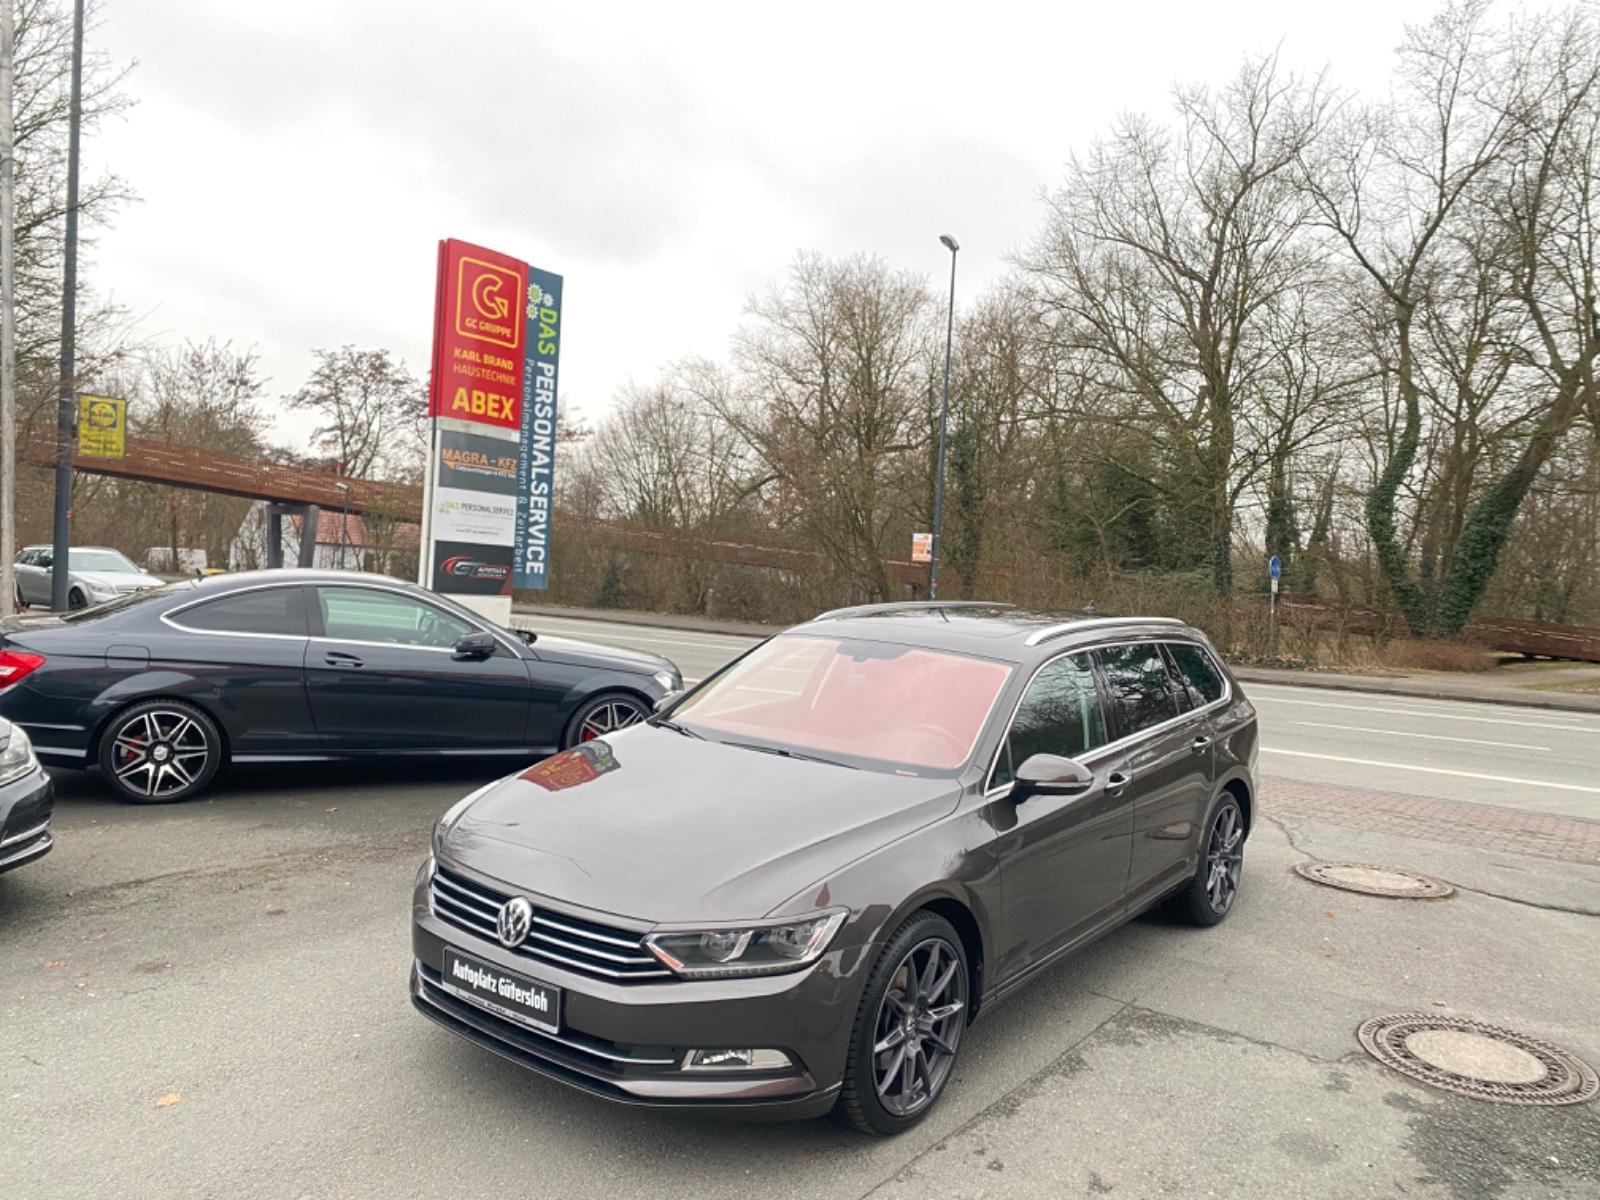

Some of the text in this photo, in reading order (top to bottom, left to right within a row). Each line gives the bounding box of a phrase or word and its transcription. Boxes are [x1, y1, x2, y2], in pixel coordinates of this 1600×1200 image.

[465, 317, 512, 338] GC GRUPPE
[453, 348, 514, 371] KARL BRAND
[453, 363, 516, 386] HAUSTECHNIK
[451, 386, 514, 421] ABEX
[518, 358, 535, 490] Personalmanagement
[525, 307, 558, 575] DAS PERSONALSERVICE
[442, 448, 488, 466] MAGRA
[498, 457, 517, 471] KFZ
[461, 502, 514, 517] PERSONALSERVICE
[513, 512, 527, 573] Zeitarbeit
[452, 959, 497, 993] Autoplatz
[498, 977, 548, 1012] Gütersloh
